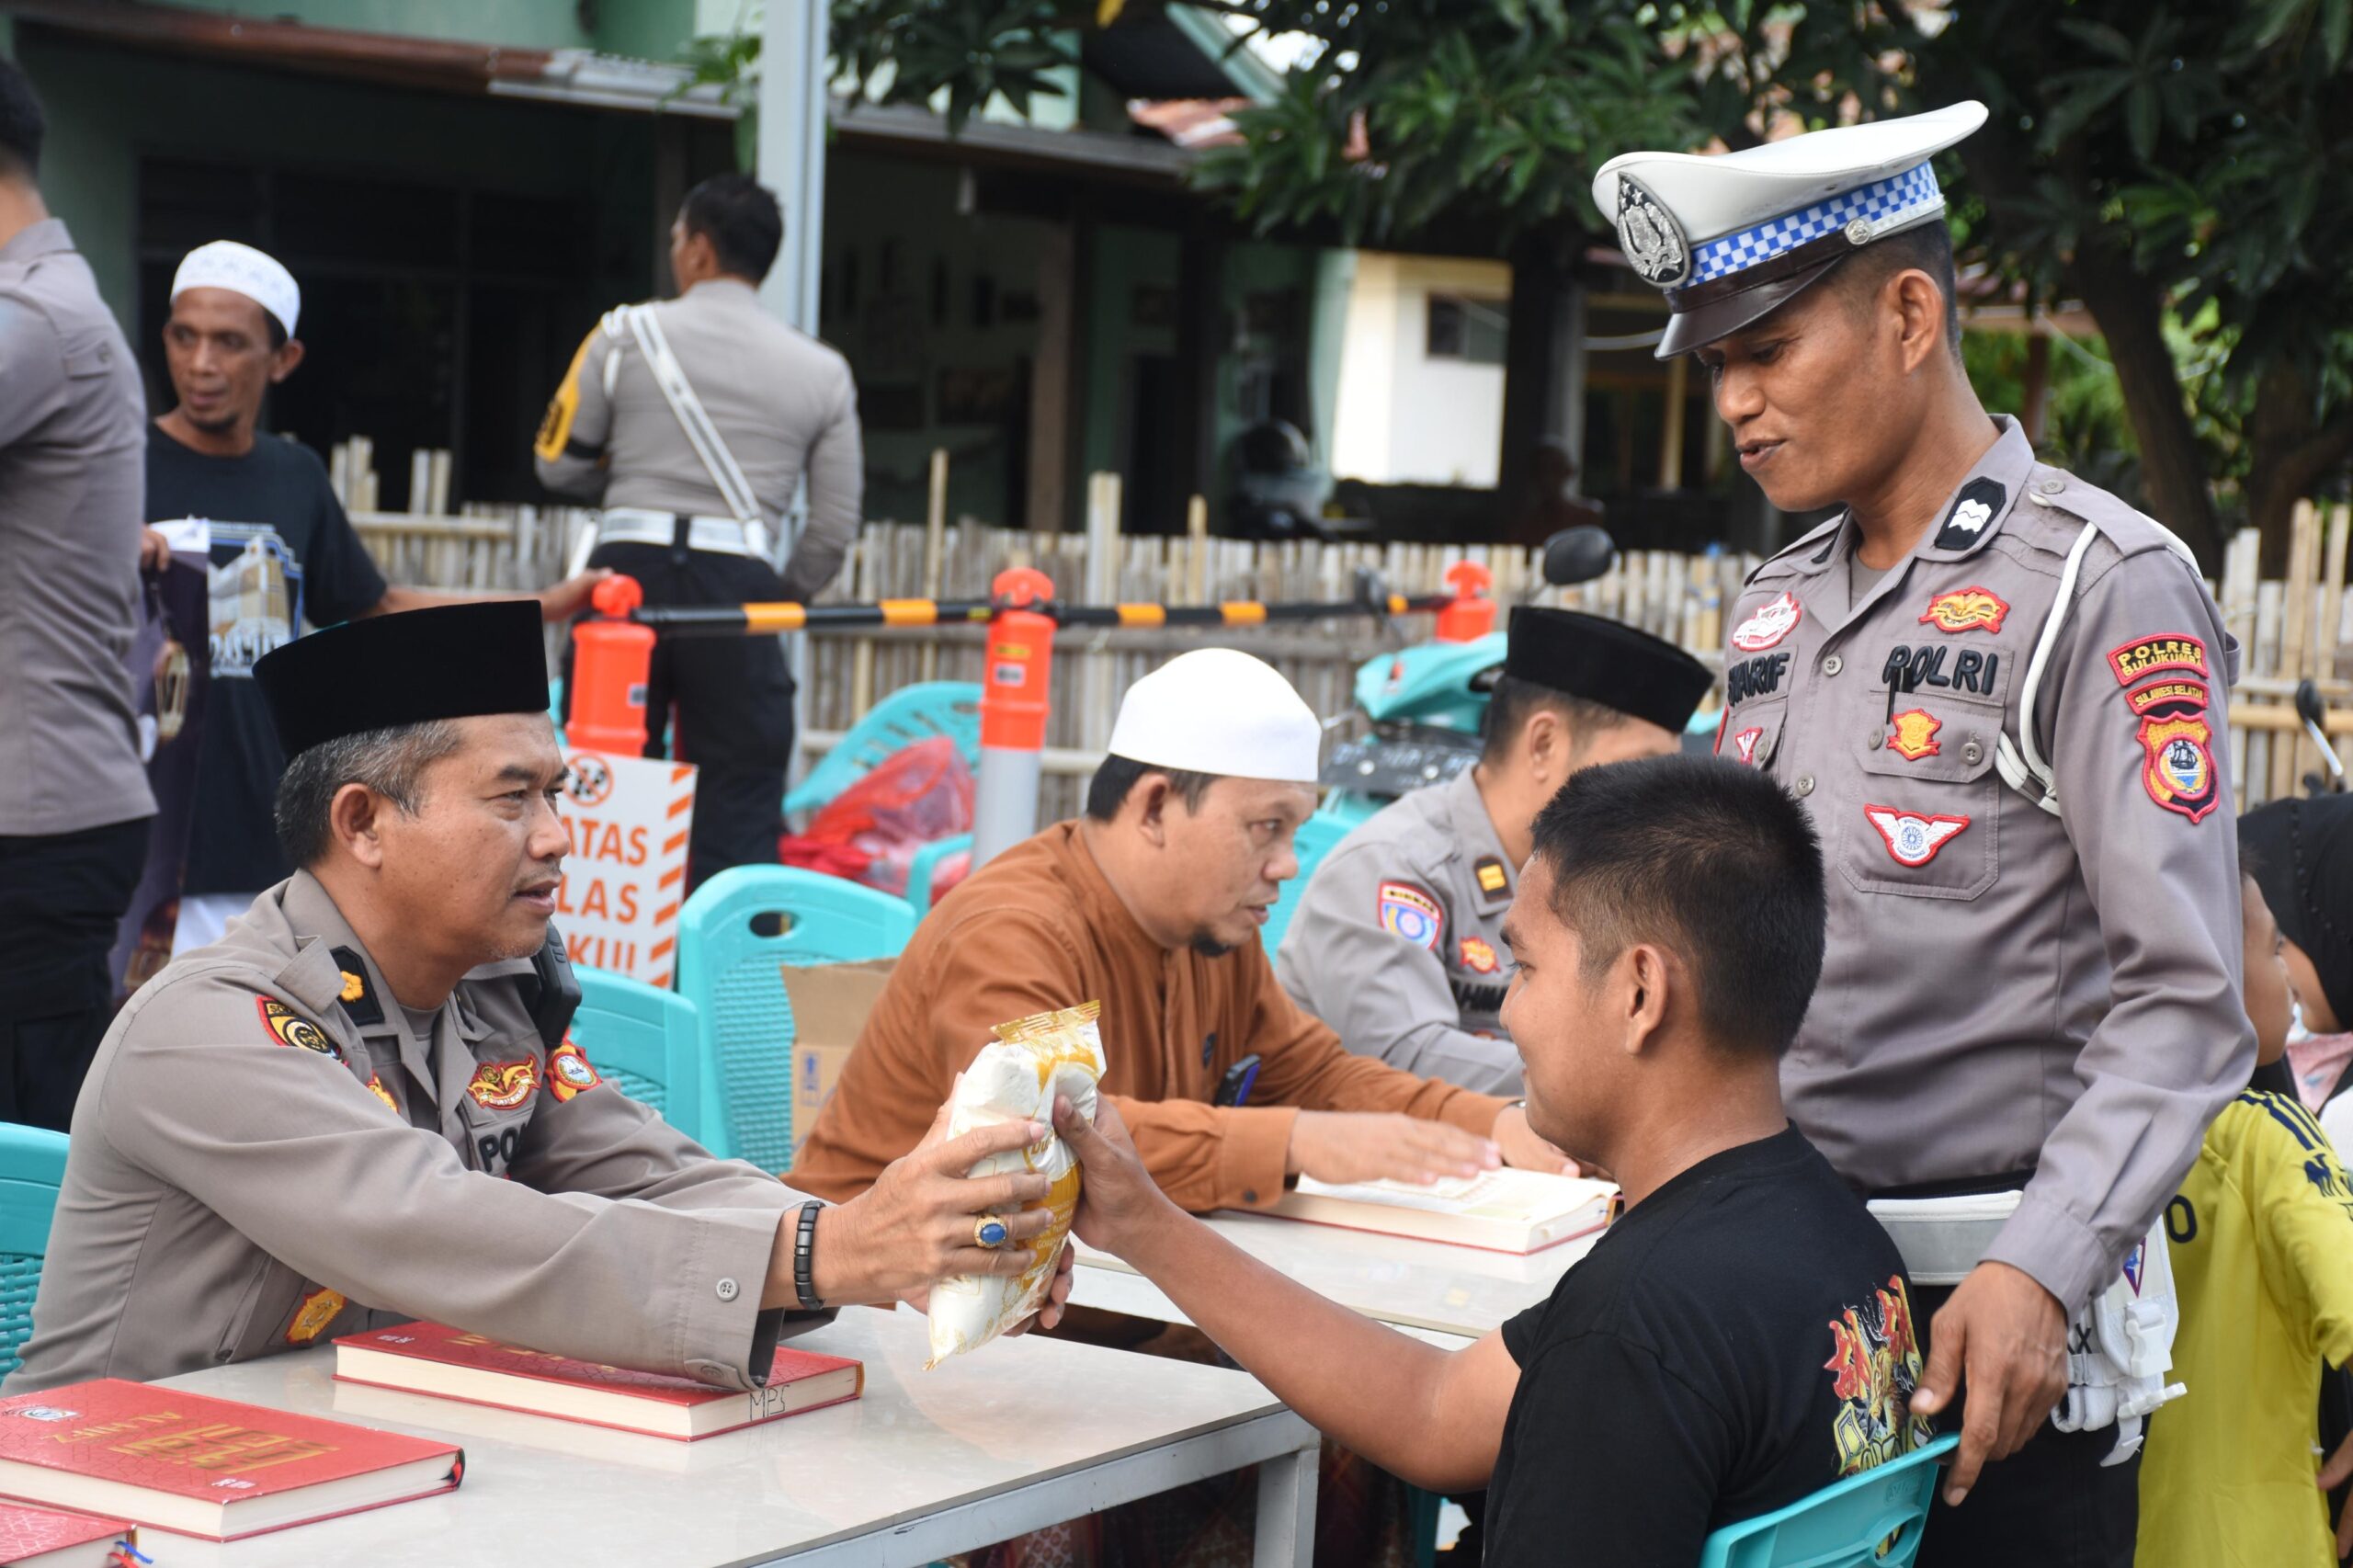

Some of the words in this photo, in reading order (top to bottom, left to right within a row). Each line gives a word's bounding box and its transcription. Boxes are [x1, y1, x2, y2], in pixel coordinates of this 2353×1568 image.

[1881, 644, 1999, 696] POLRI
[2118, 641, 2202, 667] POLRES
[2122, 653, 2203, 677] BULUKUMBA
[561, 816, 648, 866] ATAS
[557, 873, 638, 925] LAS
[478, 1126, 523, 1174] PO
